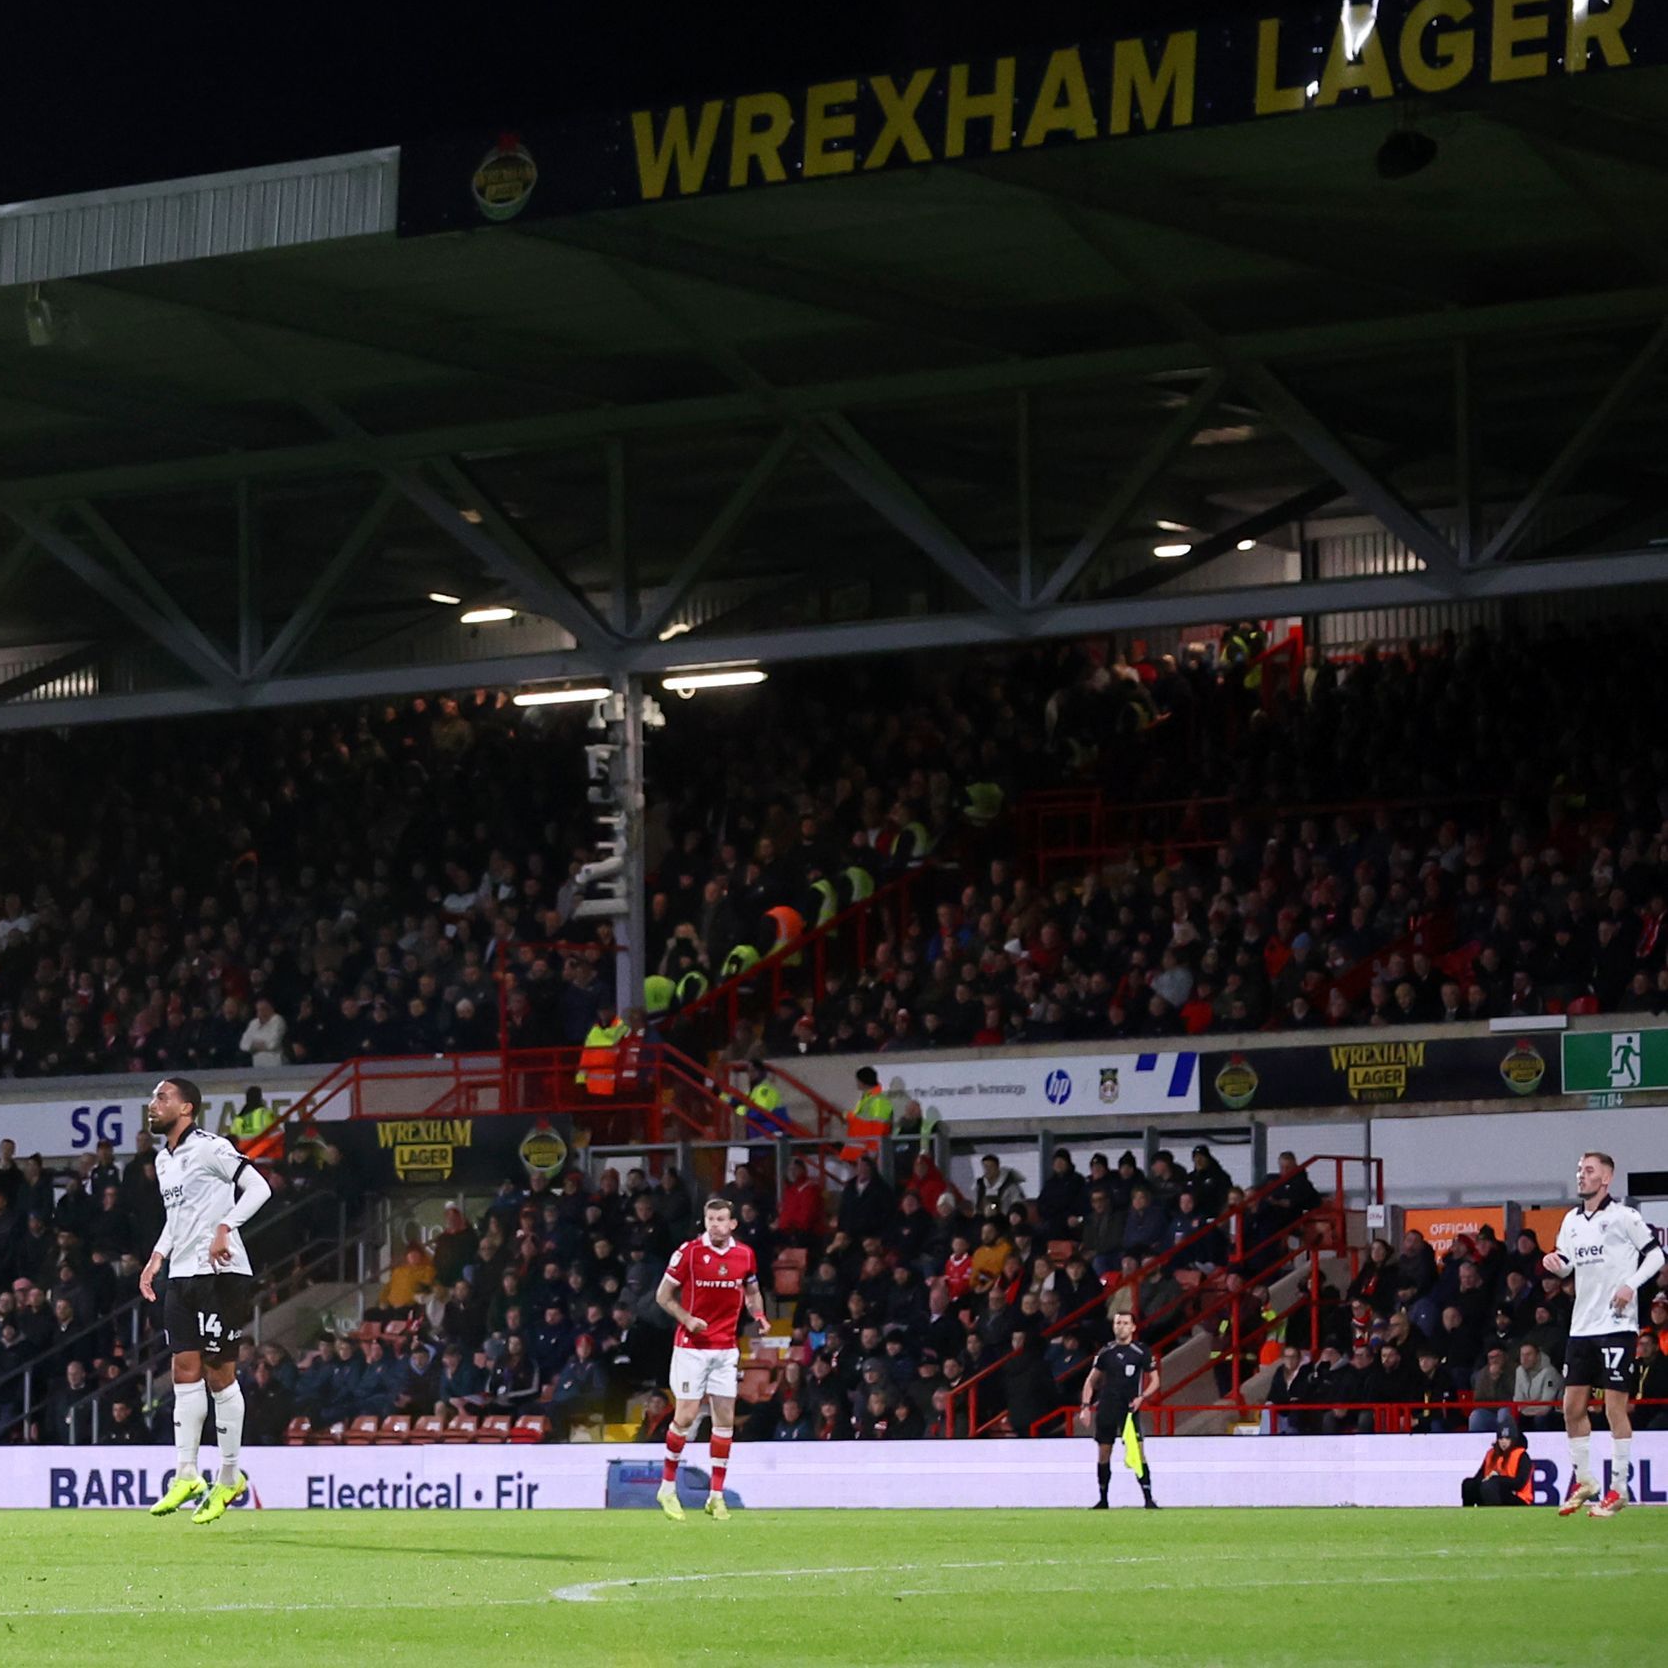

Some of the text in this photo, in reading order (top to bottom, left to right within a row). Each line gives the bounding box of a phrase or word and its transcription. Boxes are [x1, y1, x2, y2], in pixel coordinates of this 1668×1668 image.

[630, 30, 1198, 200] WREXHAM
[1330, 1042, 1426, 1070] WREXHAM
[1047, 1070, 1070, 1105] hp
[1353, 1067, 1403, 1086] LAGER
[71, 1105, 123, 1148] SG
[377, 1119, 472, 1148] WREXHAM
[399, 1147, 449, 1166] LAGER
[695, 1279, 735, 1289] UNITED
[197, 1311, 222, 1338] 14
[1601, 1347, 1624, 1369] 17
[307, 1472, 539, 1510] Electrical Fir
